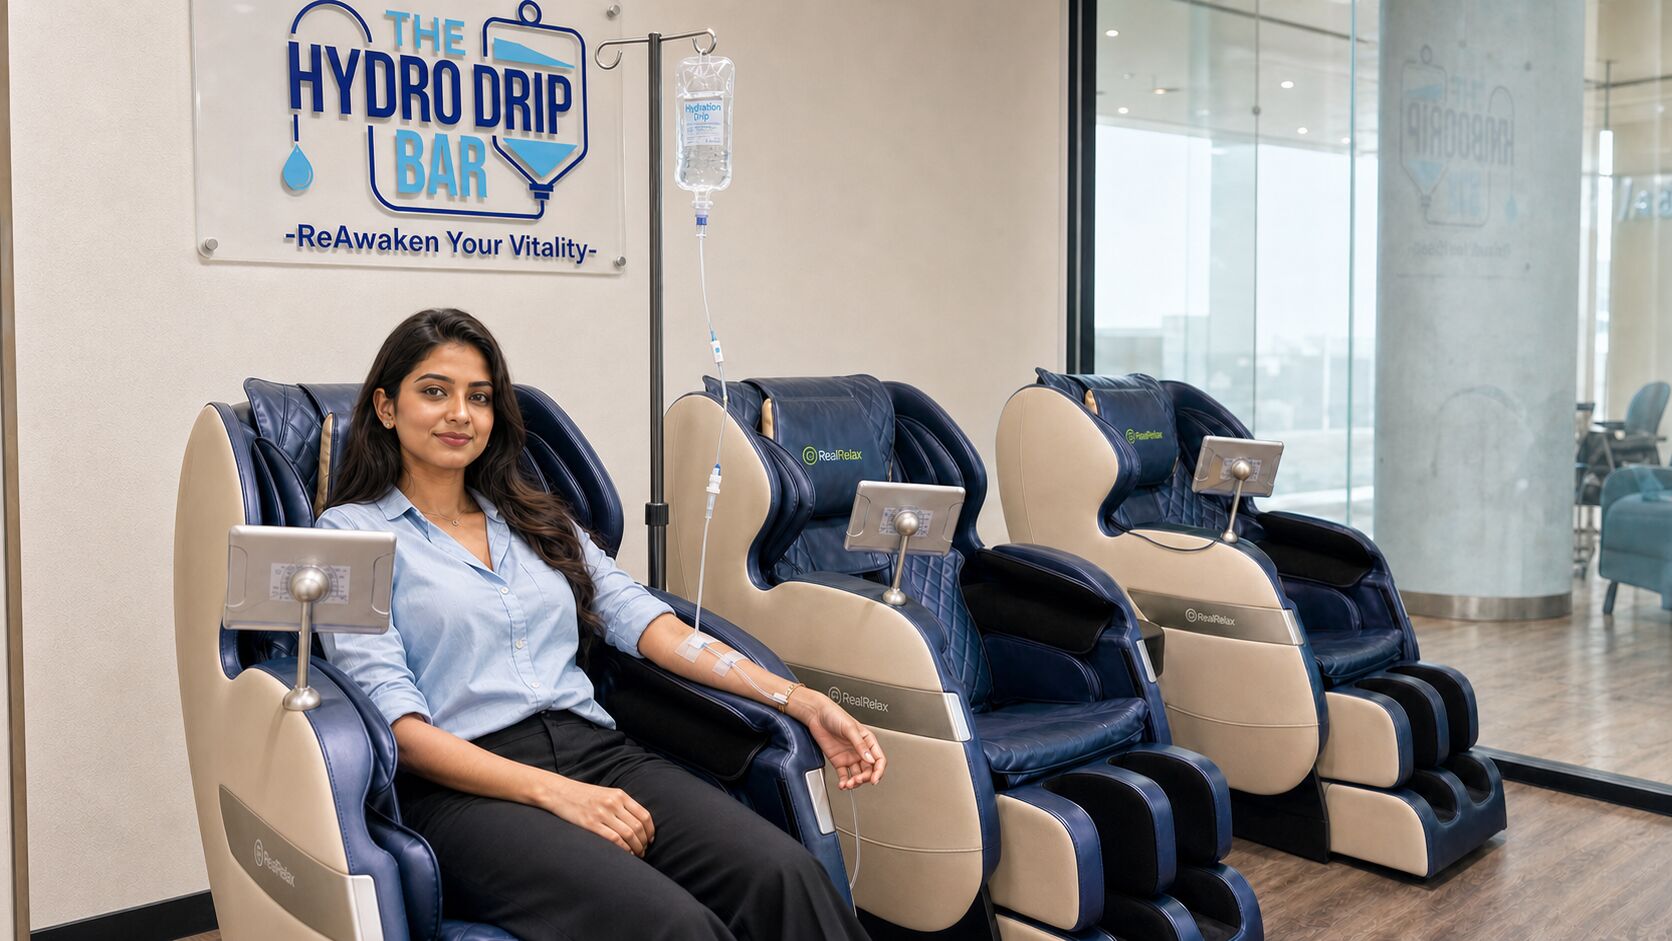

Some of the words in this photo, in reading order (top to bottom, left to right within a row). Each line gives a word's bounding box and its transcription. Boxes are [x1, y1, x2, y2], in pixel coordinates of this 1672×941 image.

[385, 9, 467, 56] THE
[288, 41, 462, 125] HYDRO
[474, 63, 573, 135] DRIP
[685, 103, 721, 113] Hydration
[396, 129, 488, 198] BAR
[285, 223, 440, 253] -ReAwaken
[446, 230, 504, 256] Your
[509, 234, 598, 264] Vitality-
[818, 449, 863, 461] RealRelax
[842, 691, 889, 713] RealRelax
